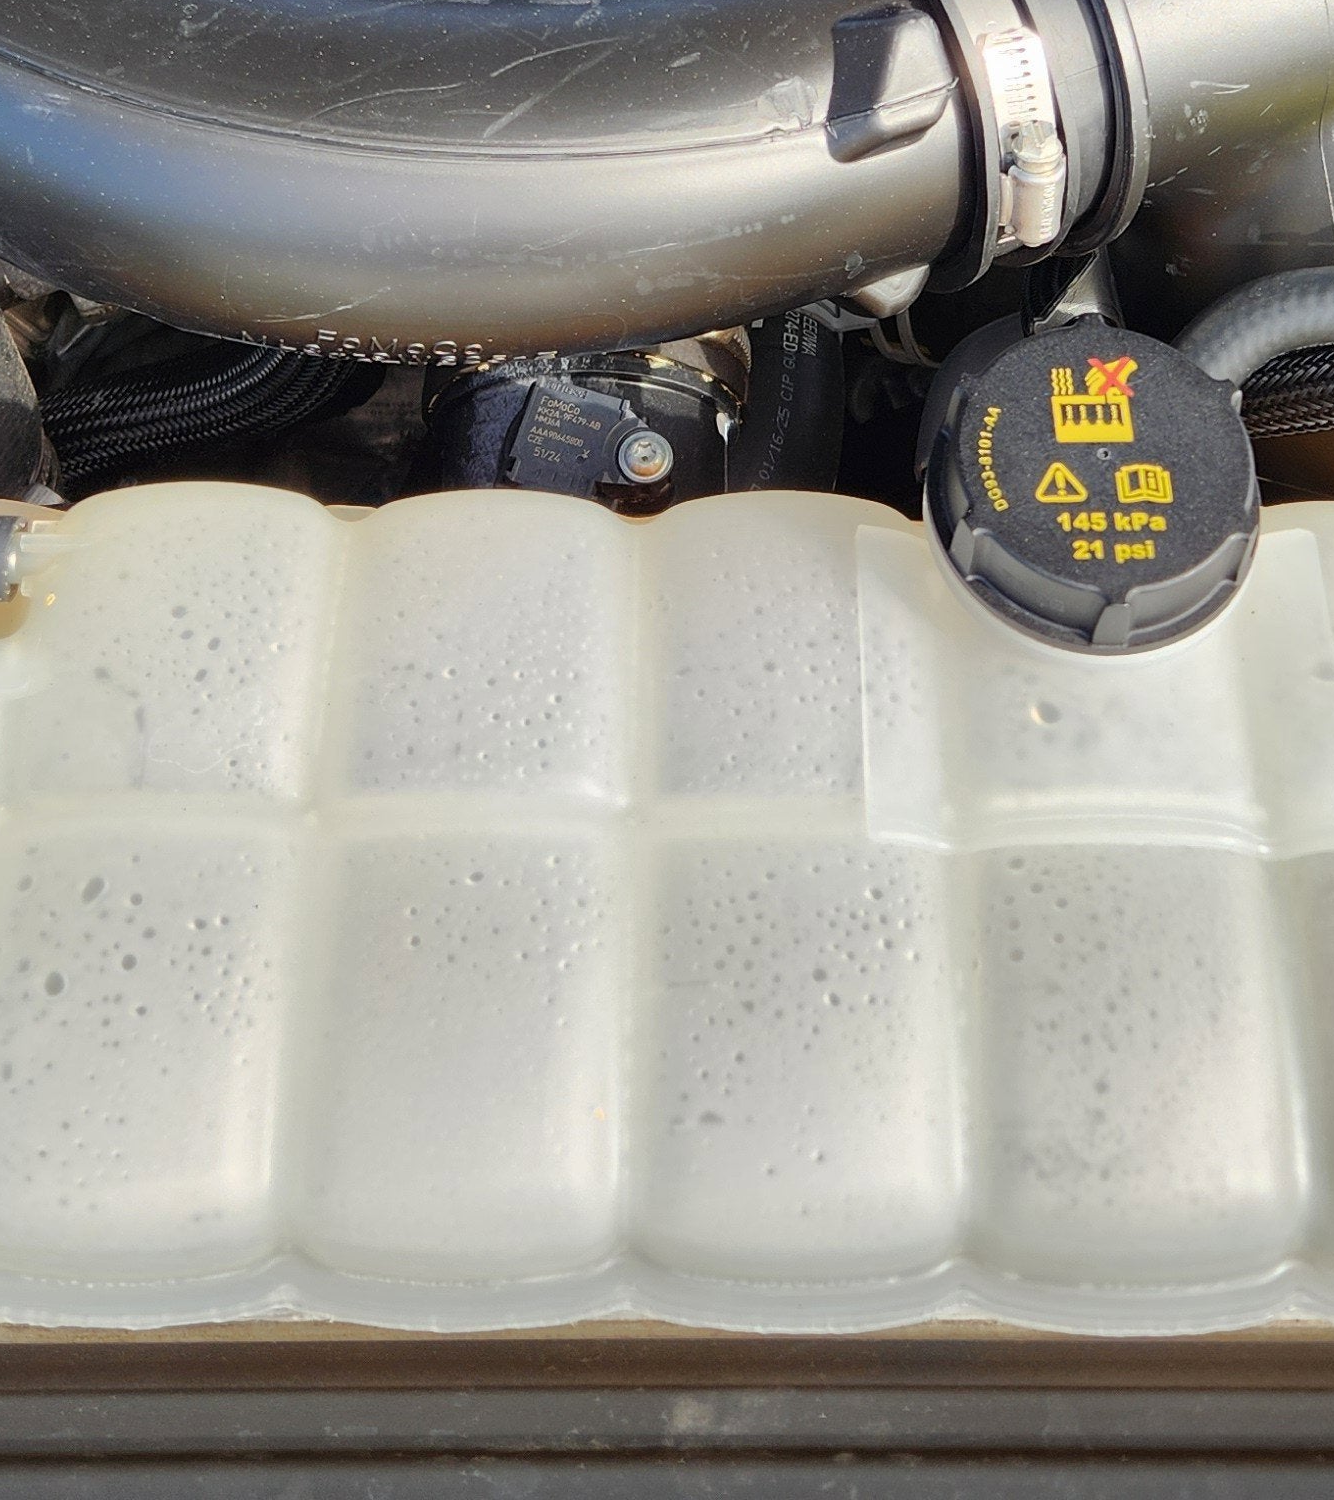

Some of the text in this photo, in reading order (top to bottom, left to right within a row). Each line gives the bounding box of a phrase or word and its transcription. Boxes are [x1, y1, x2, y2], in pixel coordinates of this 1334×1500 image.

[539, 394, 581, 414] FoMoCo
[526, 434, 543, 445] CZE
[533, 446, 561, 462] 51/24
[1056, 511, 1167, 532] 145 kPa
[1072, 540, 1155, 564] 21 psi
